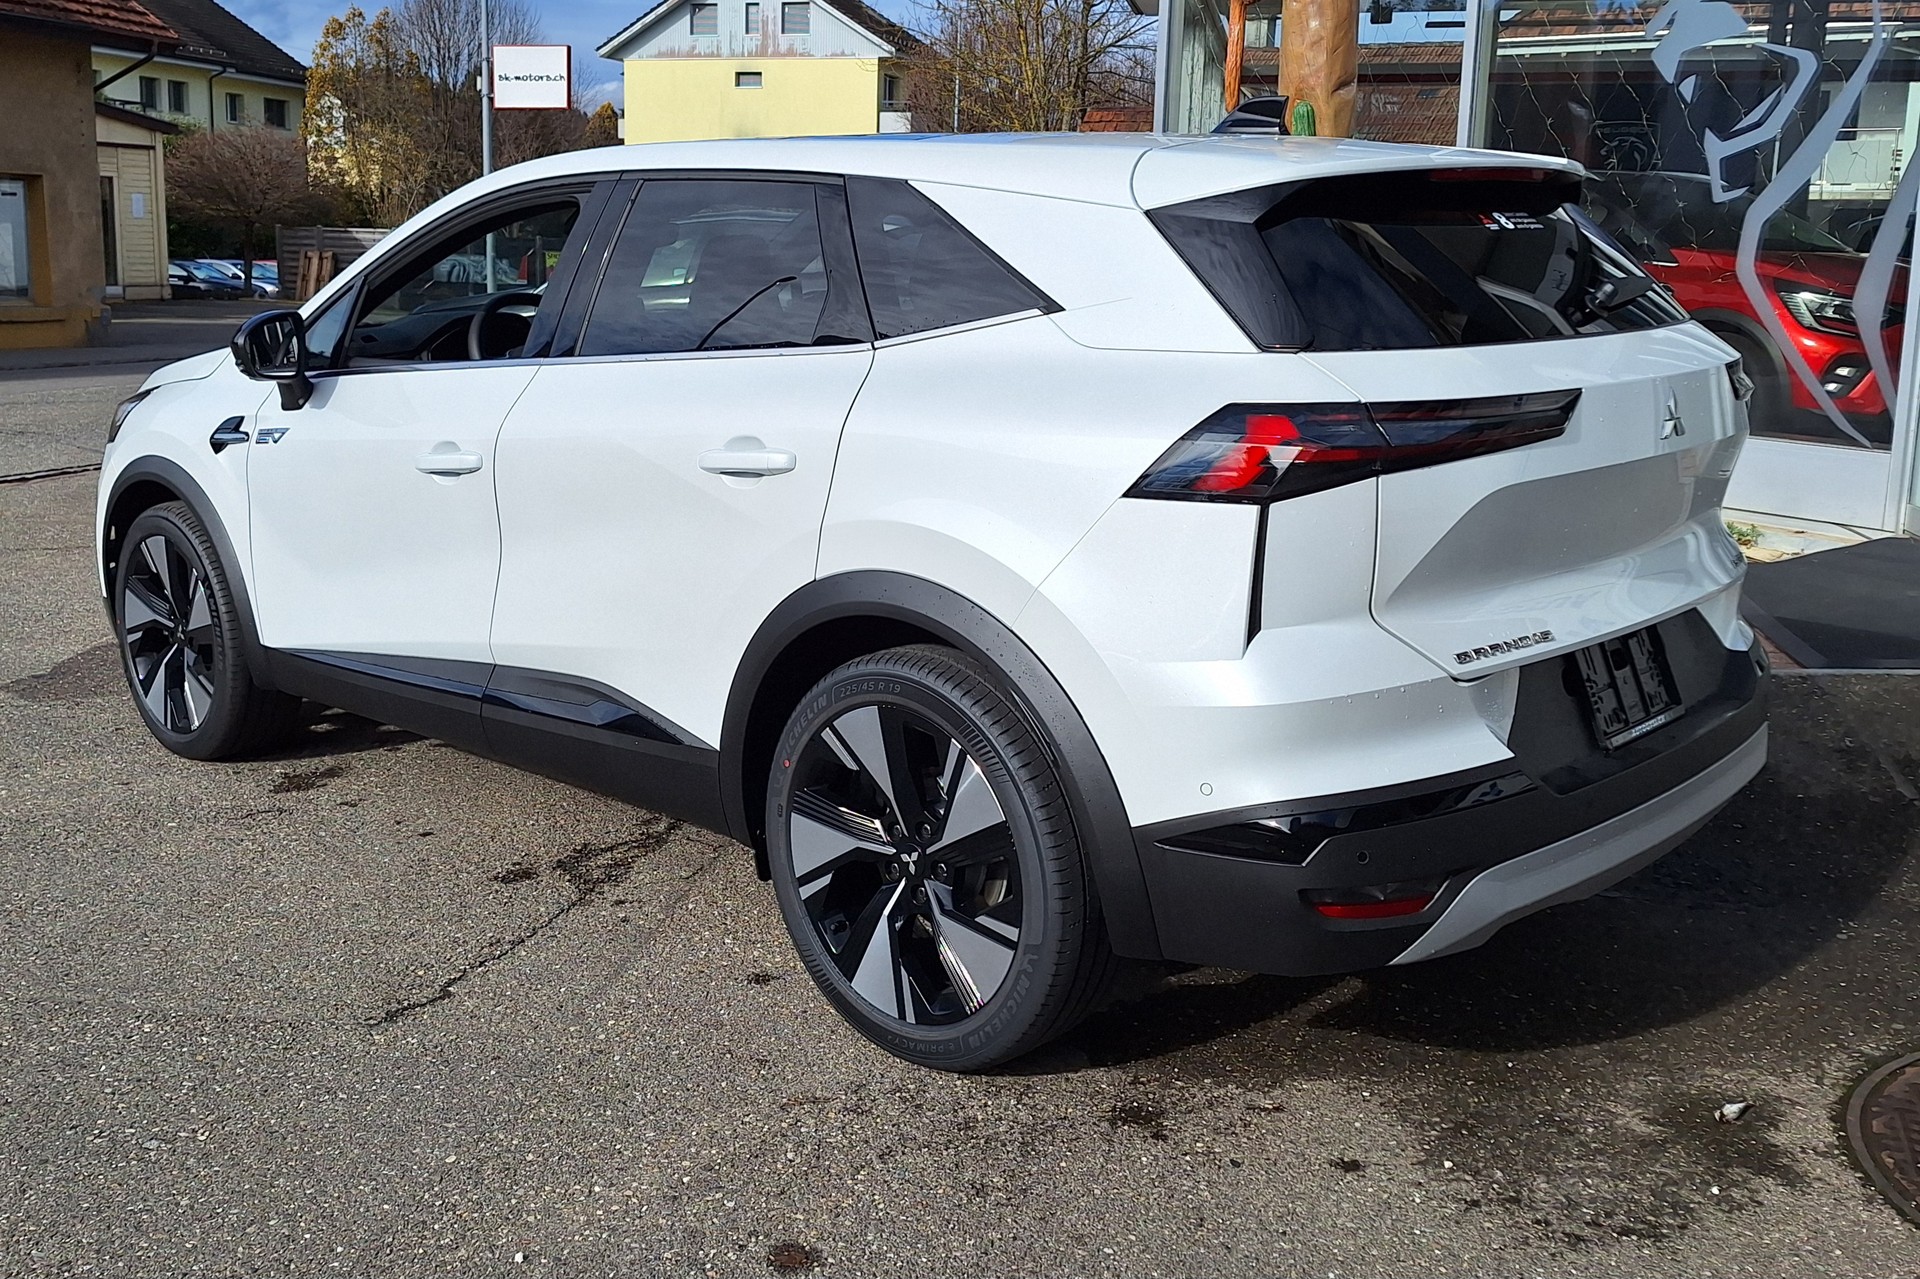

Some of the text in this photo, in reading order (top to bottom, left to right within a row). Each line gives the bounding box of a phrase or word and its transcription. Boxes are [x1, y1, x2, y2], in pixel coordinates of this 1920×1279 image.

[1492, 212, 1515, 229] 8
[256, 427, 291, 444] EV
[1453, 629, 1556, 665] GRANDIS
[840, 681, 901, 698] 225/45 R 19
